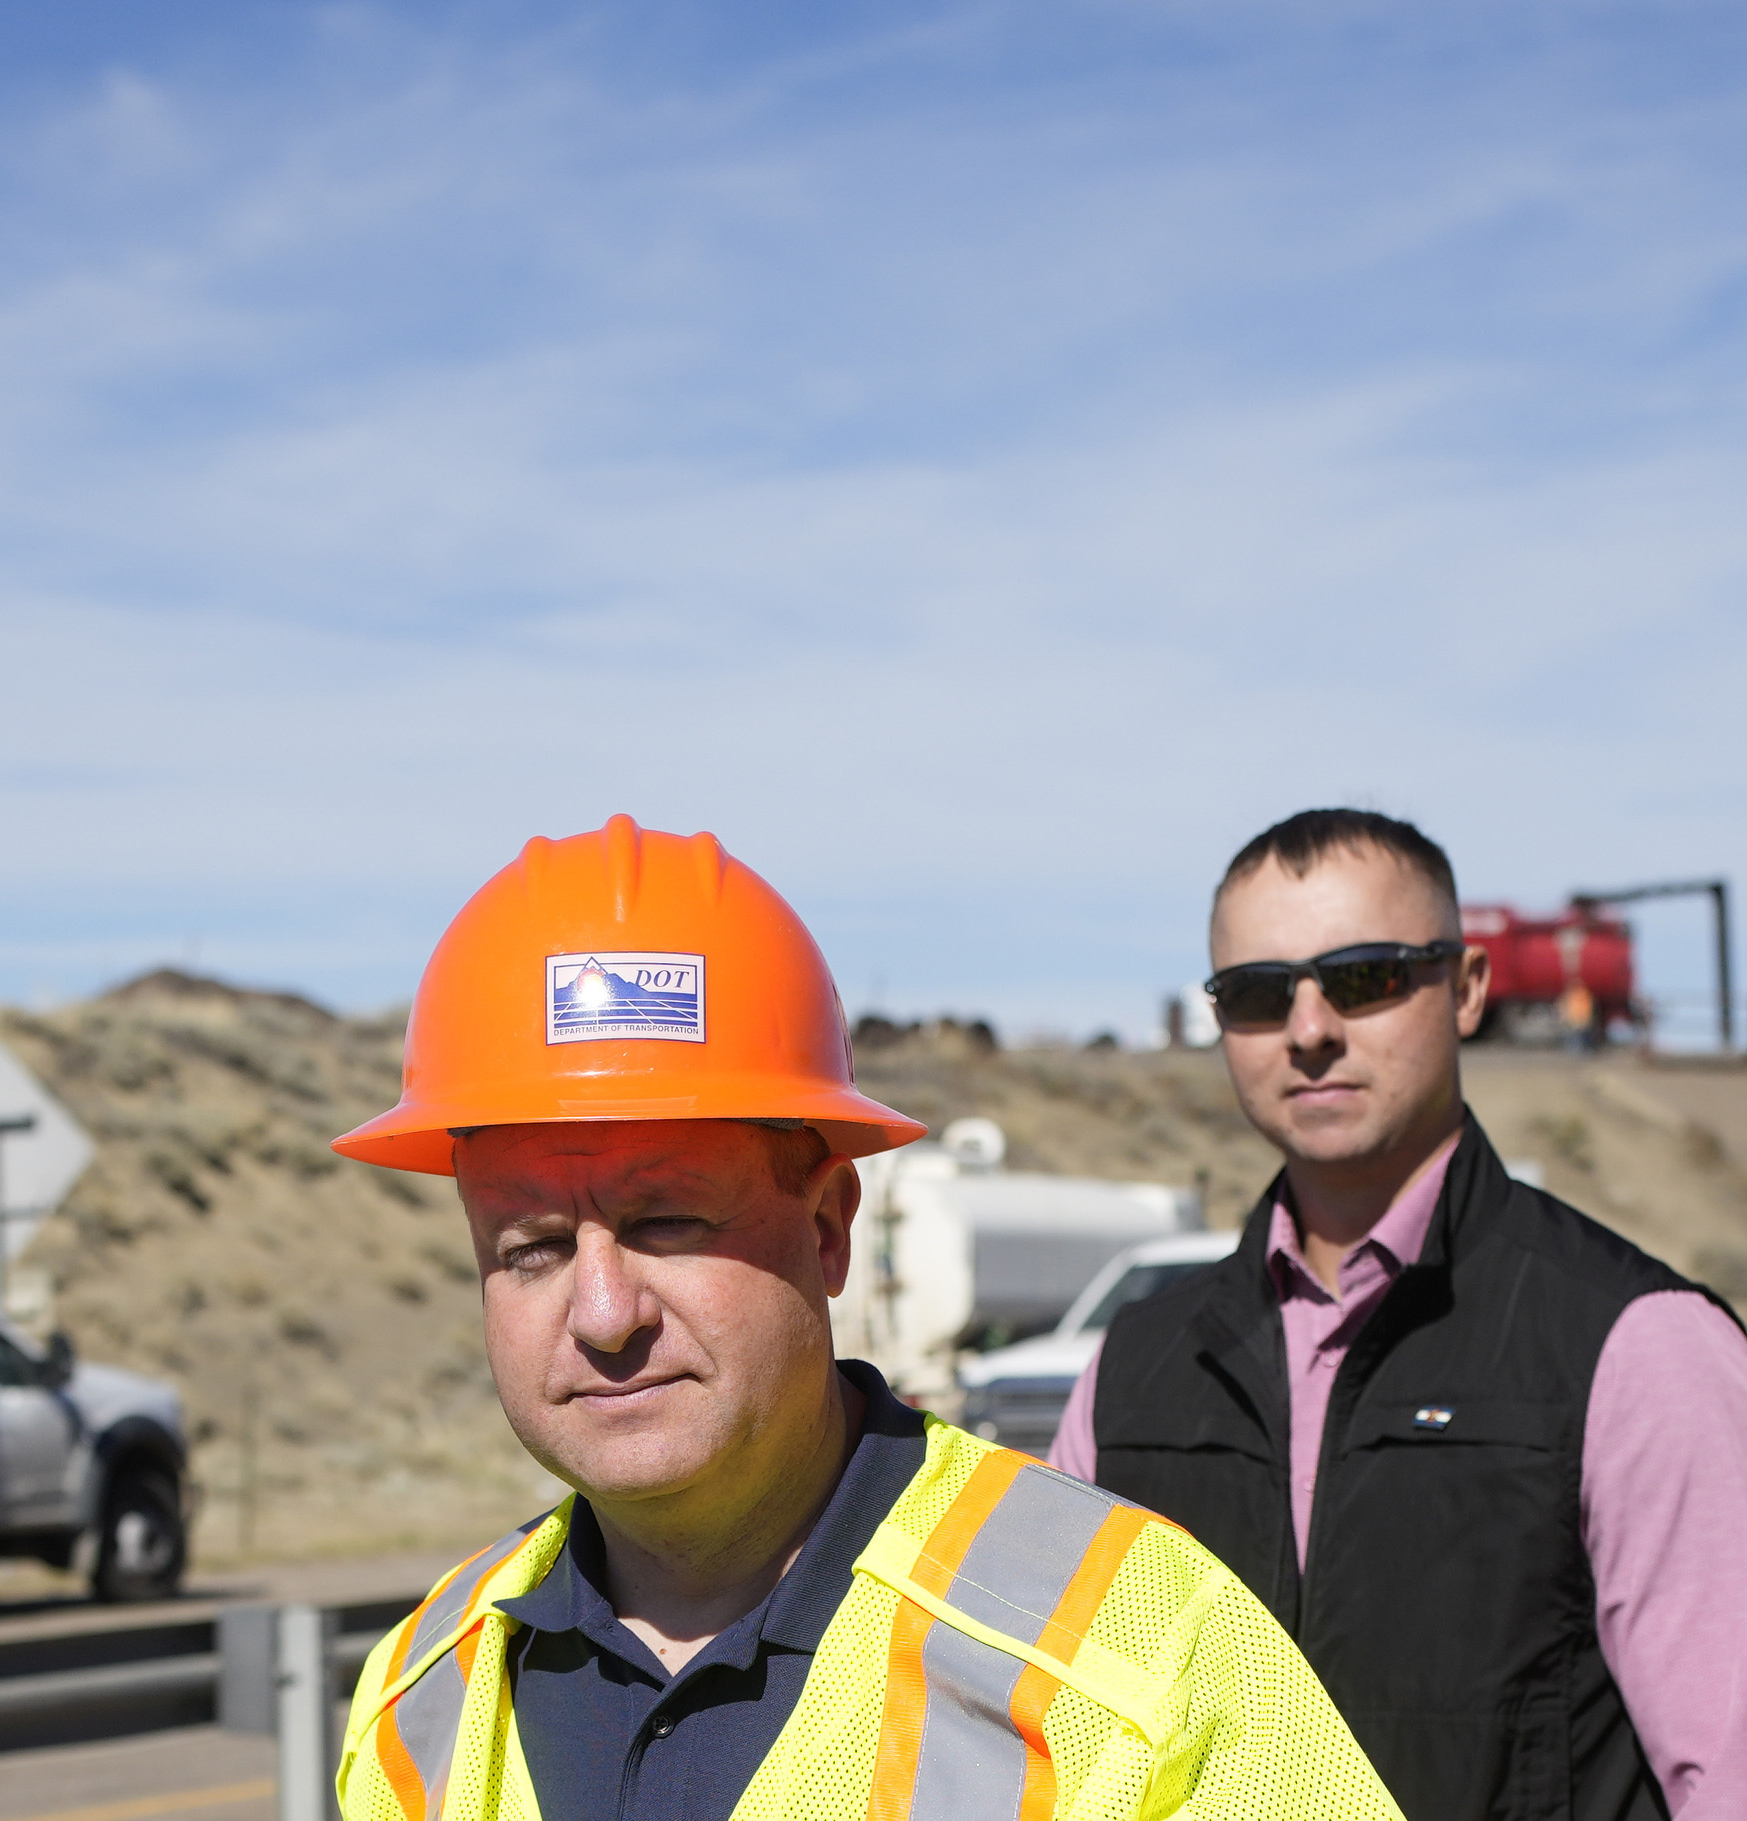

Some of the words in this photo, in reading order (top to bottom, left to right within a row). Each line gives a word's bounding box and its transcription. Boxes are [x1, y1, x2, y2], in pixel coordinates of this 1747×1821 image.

[635, 969, 690, 989] DOT
[553, 1024, 608, 1036] DEPARTMENT
[611, 1024, 622, 1032] OF
[624, 1024, 699, 1035] TRANSPORTATION
